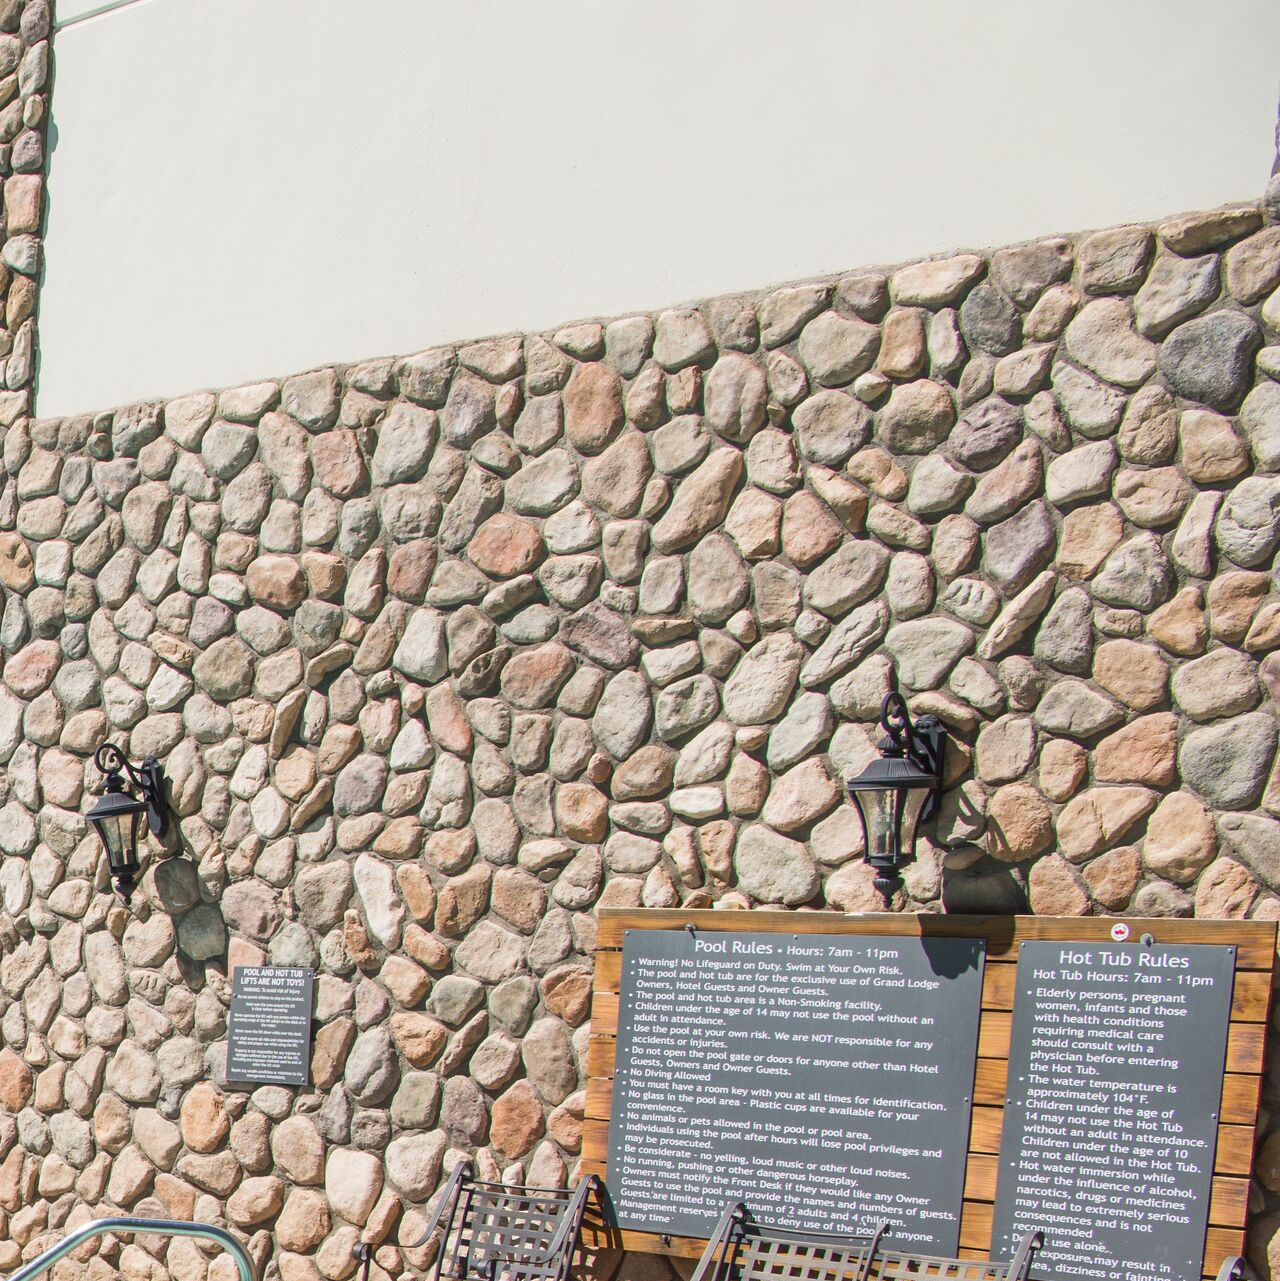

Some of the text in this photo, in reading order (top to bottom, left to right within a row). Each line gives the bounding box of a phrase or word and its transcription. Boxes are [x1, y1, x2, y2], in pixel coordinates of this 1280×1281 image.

[695, 939, 773, 954] Pool Rules
[787, 945, 823, 956] Hours:
[828, 946, 852, 956] 7am
[866, 948, 898, 960] 11pm
[638, 957, 678, 967] Warning!
[681, 959, 693, 967] No
[696, 959, 740, 969] Lifeguard
[757, 961, 782, 972] Duty.
[785, 962, 812, 971] Swim
[814, 964, 825, 972] at
[827, 964, 850, 972] Your
[853, 964, 875, 973] Own
[878, 965, 902, 974] Risk.
[1059, 950, 1189, 968] Hot Tub Rules
[241, 977, 258, 985] LIFTS
[271, 978, 285, 986] NOT
[244, 968, 260, 976] POOL
[261, 969, 273, 977] AND
[275, 969, 288, 977] HOT
[1033, 969, 1056, 979] Hot
[1059, 969, 1082, 980] Tub
[1087, 971, 1128, 982] Hours:
[1134, 972, 1161, 983] 7am
[1177, 974, 1213, 987] 11pm
[1036, 987, 1185, 1003] Elderly persons, pregnant
[1035, 1002, 1187, 1016] women, infants and those
[1034, 1013, 1164, 1028] with health conditions
[1032, 1026, 1163, 1040] requiring medical care
[1031, 1037, 1153, 1053] should consult with a
[630, 1056, 791, 1075] Guests, Owners and Owner Guests.
[1030, 1050, 1178, 1069] physician before entering
[1030, 1062, 1099, 1075] the Hot Tub.
[630, 1068, 711, 1081] No Diving Allowed
[1027, 1074, 1176, 1093] The water temperature is
[1027, 1088, 1148, 1104] approximately 104°F.
[1025, 1098, 1174, 1118] Children under the age of
[1025, 1111, 1183, 1132] 14 may not use the Hot Tub
[1023, 1124, 1066, 1135] without
[1087, 1129, 1117, 1140] adult
[1121, 1131, 1132, 1141] in
[1135, 1134, 1208, 1147] attendance.
[1022, 1135, 1188, 1158] Children under the age of 10
[1020, 1149, 1201, 1173] are not allowed in the Hot Tub.
[1019, 1160, 1175, 1183] Hot water immersion while
[1017, 1173, 1196, 1200] under the influence of alcohol,
[1016, 1186, 1071, 1199] narcotics,
[1075, 1190, 1106, 1203] drugs
[1125, 1197, 1185, 1210] medicines
[1015, 1198, 1189, 1223] may lead to extremely serious
[1012, 1222, 1092, 1238] recommended
[1014, 1210, 1152, 1232] consequences and is not
